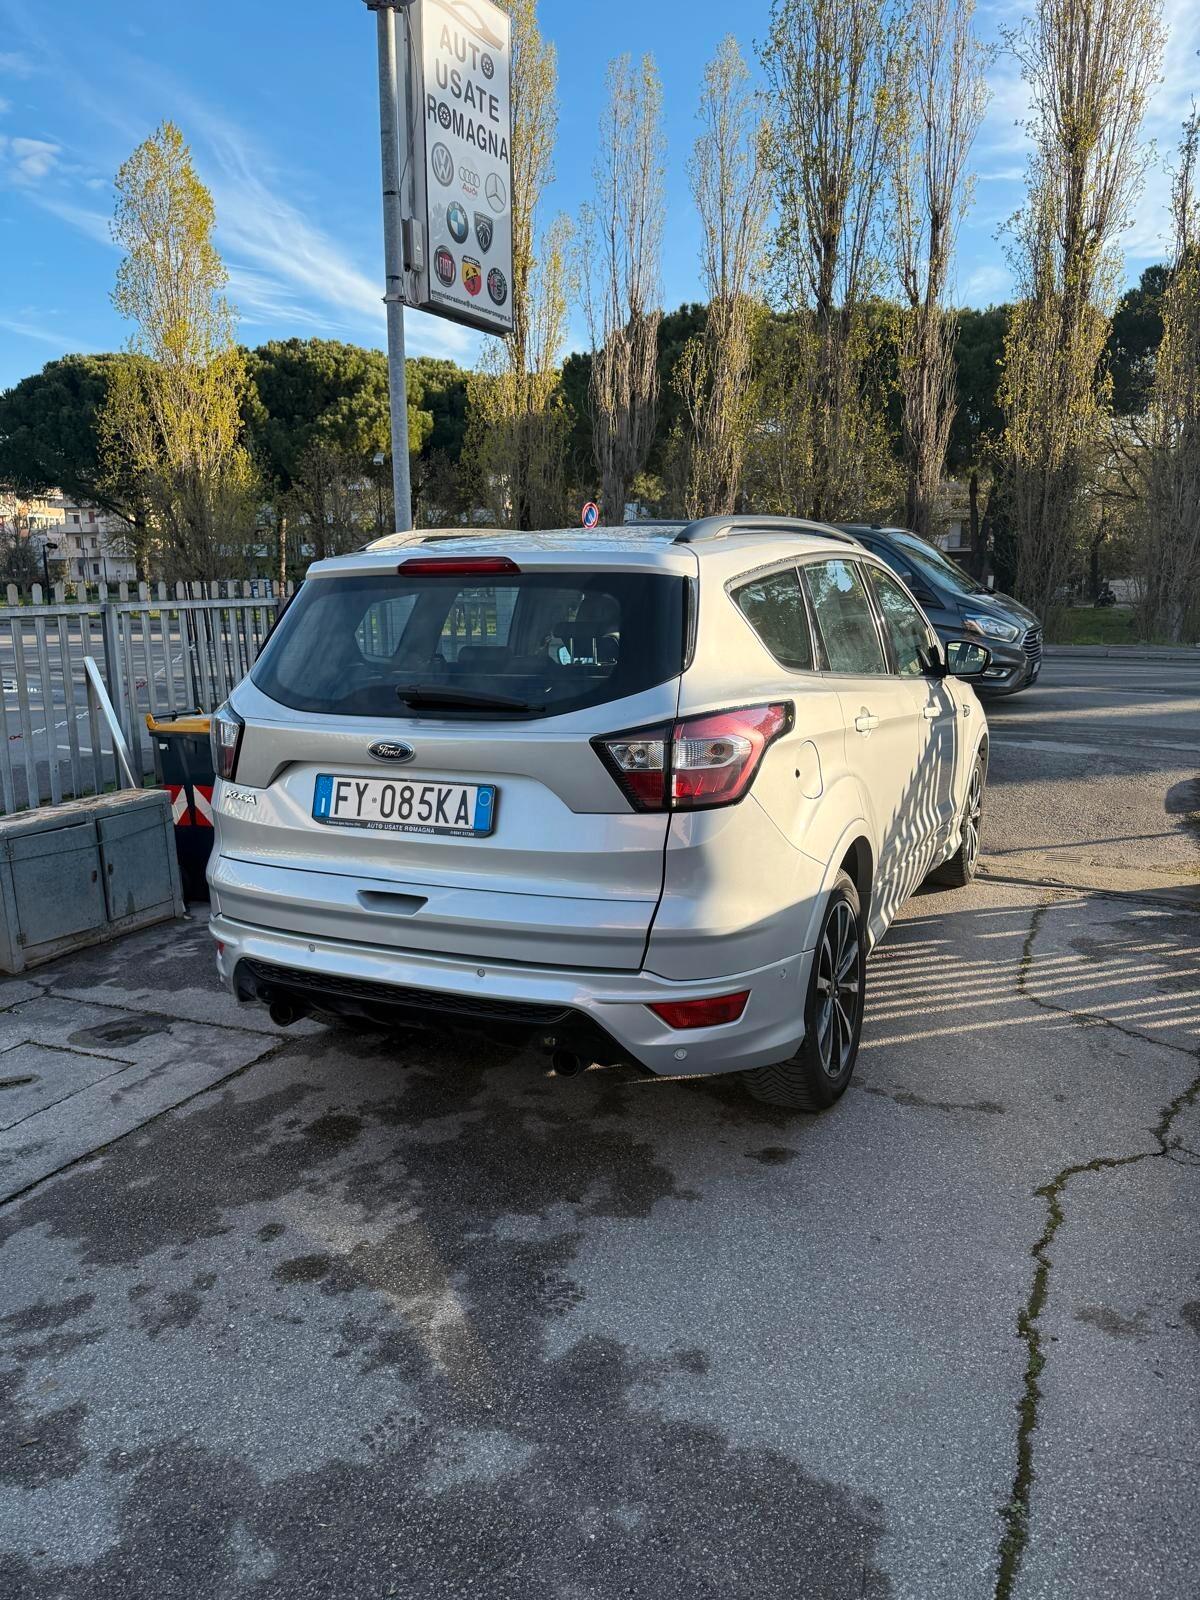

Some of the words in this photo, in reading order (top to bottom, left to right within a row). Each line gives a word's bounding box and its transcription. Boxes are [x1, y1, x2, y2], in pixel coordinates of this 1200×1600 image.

[440, 24, 495, 80] AUTO
[435, 57, 500, 123] USATE
[427, 92, 509, 164] ROMAGNA
[377, 744, 401, 758] Ford
[404, 826, 435, 834] ROMAGNA
